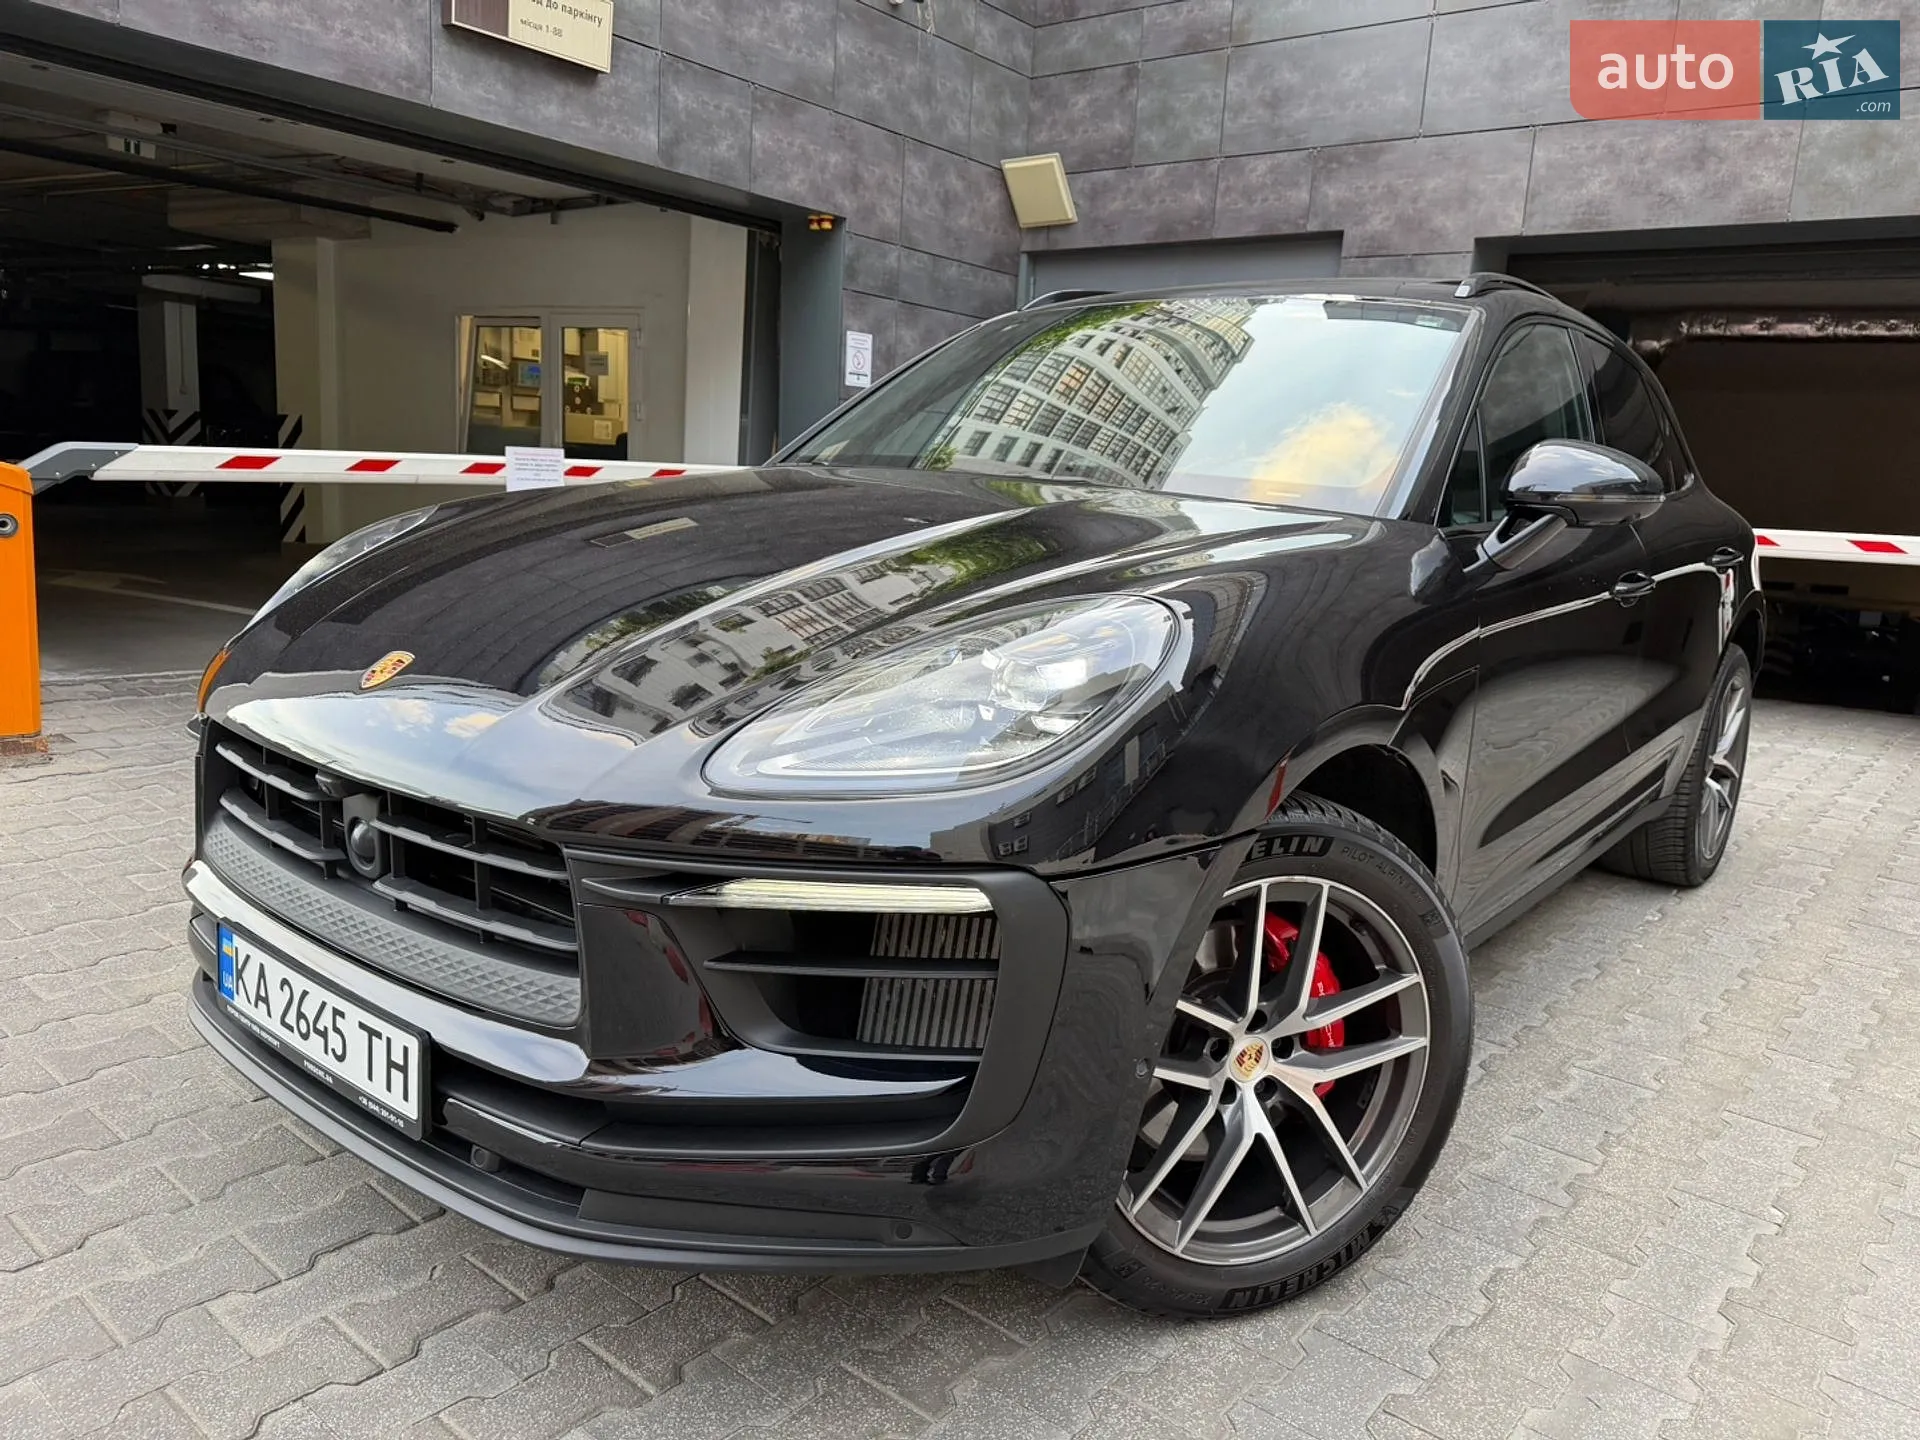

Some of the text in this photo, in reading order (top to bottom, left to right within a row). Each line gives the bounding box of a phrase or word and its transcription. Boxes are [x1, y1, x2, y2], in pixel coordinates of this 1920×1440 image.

[545, 0, 603, 28] до паркінгу
[1250, 836, 1326, 860] ELIN
[223, 971, 233, 990] UA
[234, 945, 272, 1019] KA
[279, 977, 347, 1063] 2645
[358, 1020, 410, 1104] TH
[1228, 1227, 1373, 1309] MICHELIN
